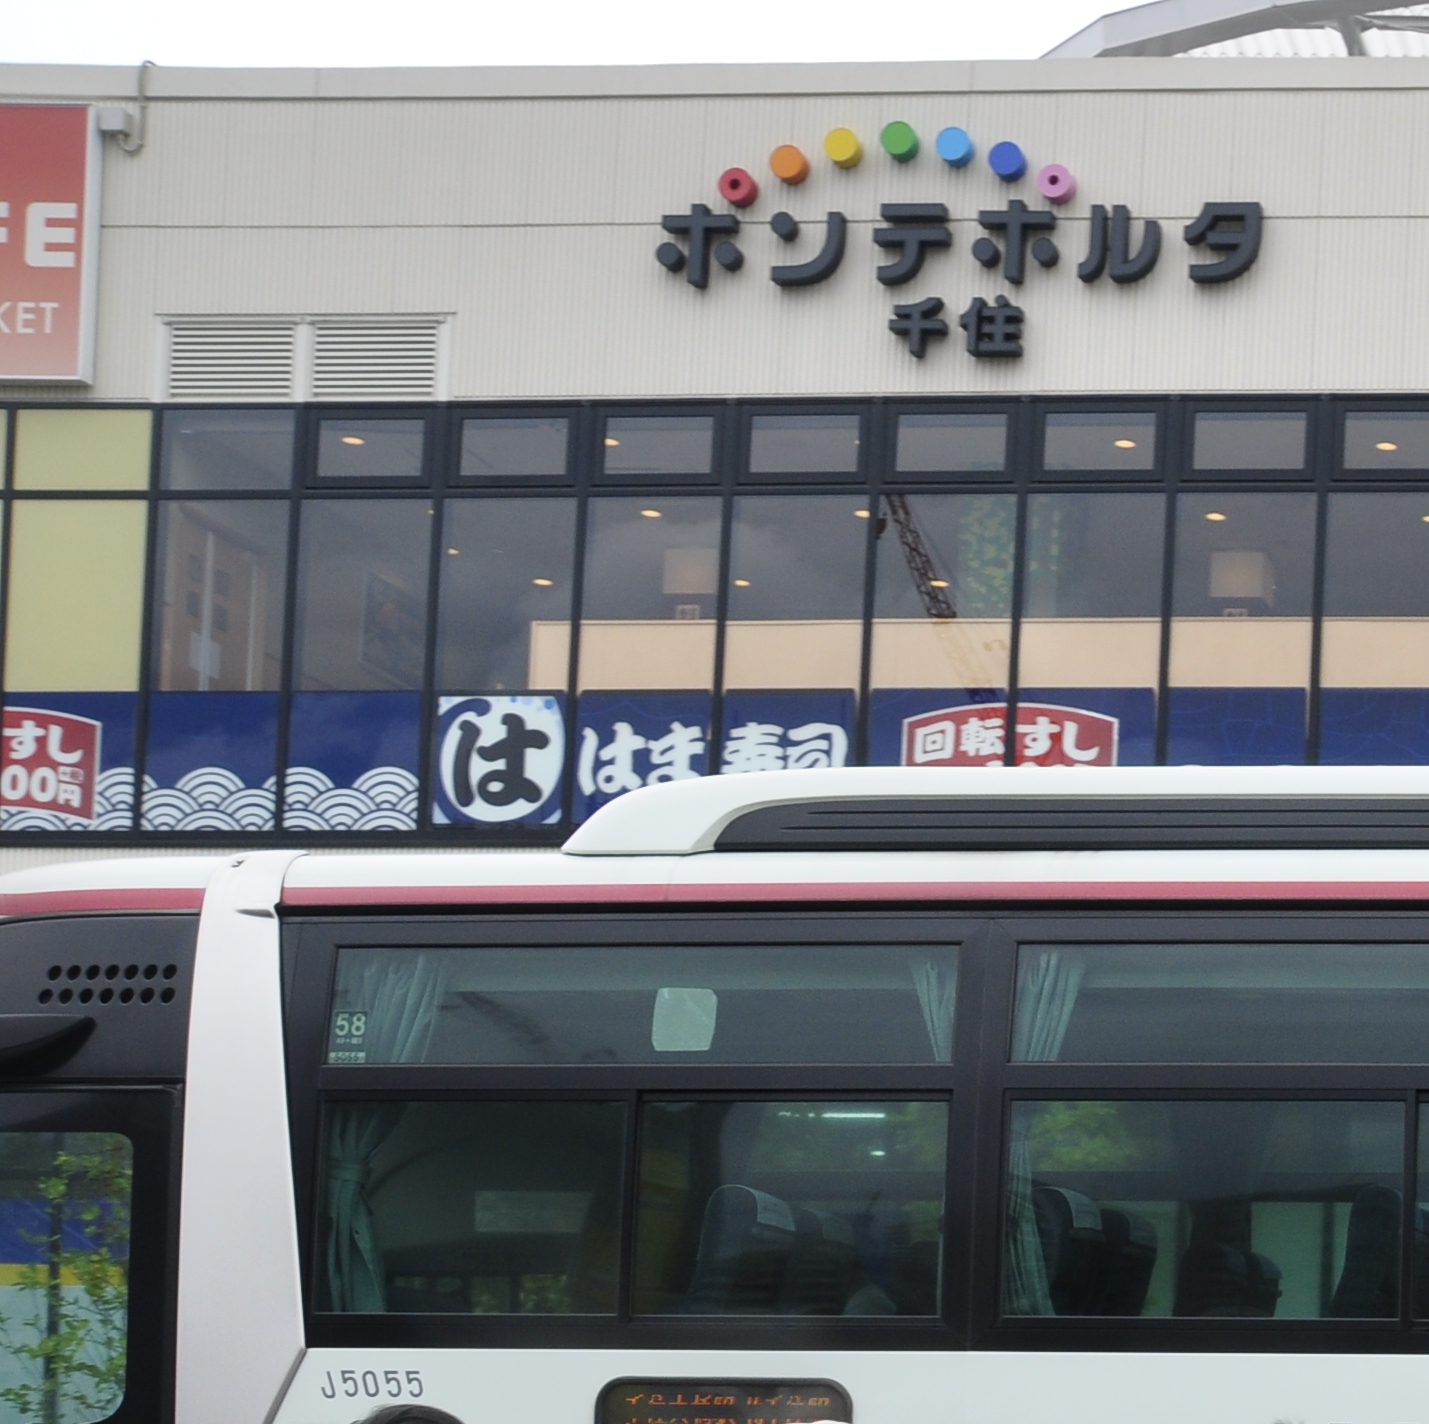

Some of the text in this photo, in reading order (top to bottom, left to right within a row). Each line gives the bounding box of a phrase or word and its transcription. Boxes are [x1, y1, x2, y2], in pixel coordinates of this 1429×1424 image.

[0, 201, 78, 268] E
[888, 295, 1026, 360] 千住
[2, 720, 84, 764] すし
[452, 713, 550, 808] は
[913, 716, 1100, 763] 回転すし
[335, 1013, 366, 1036] 58
[321, 1370, 424, 1399] J5055
